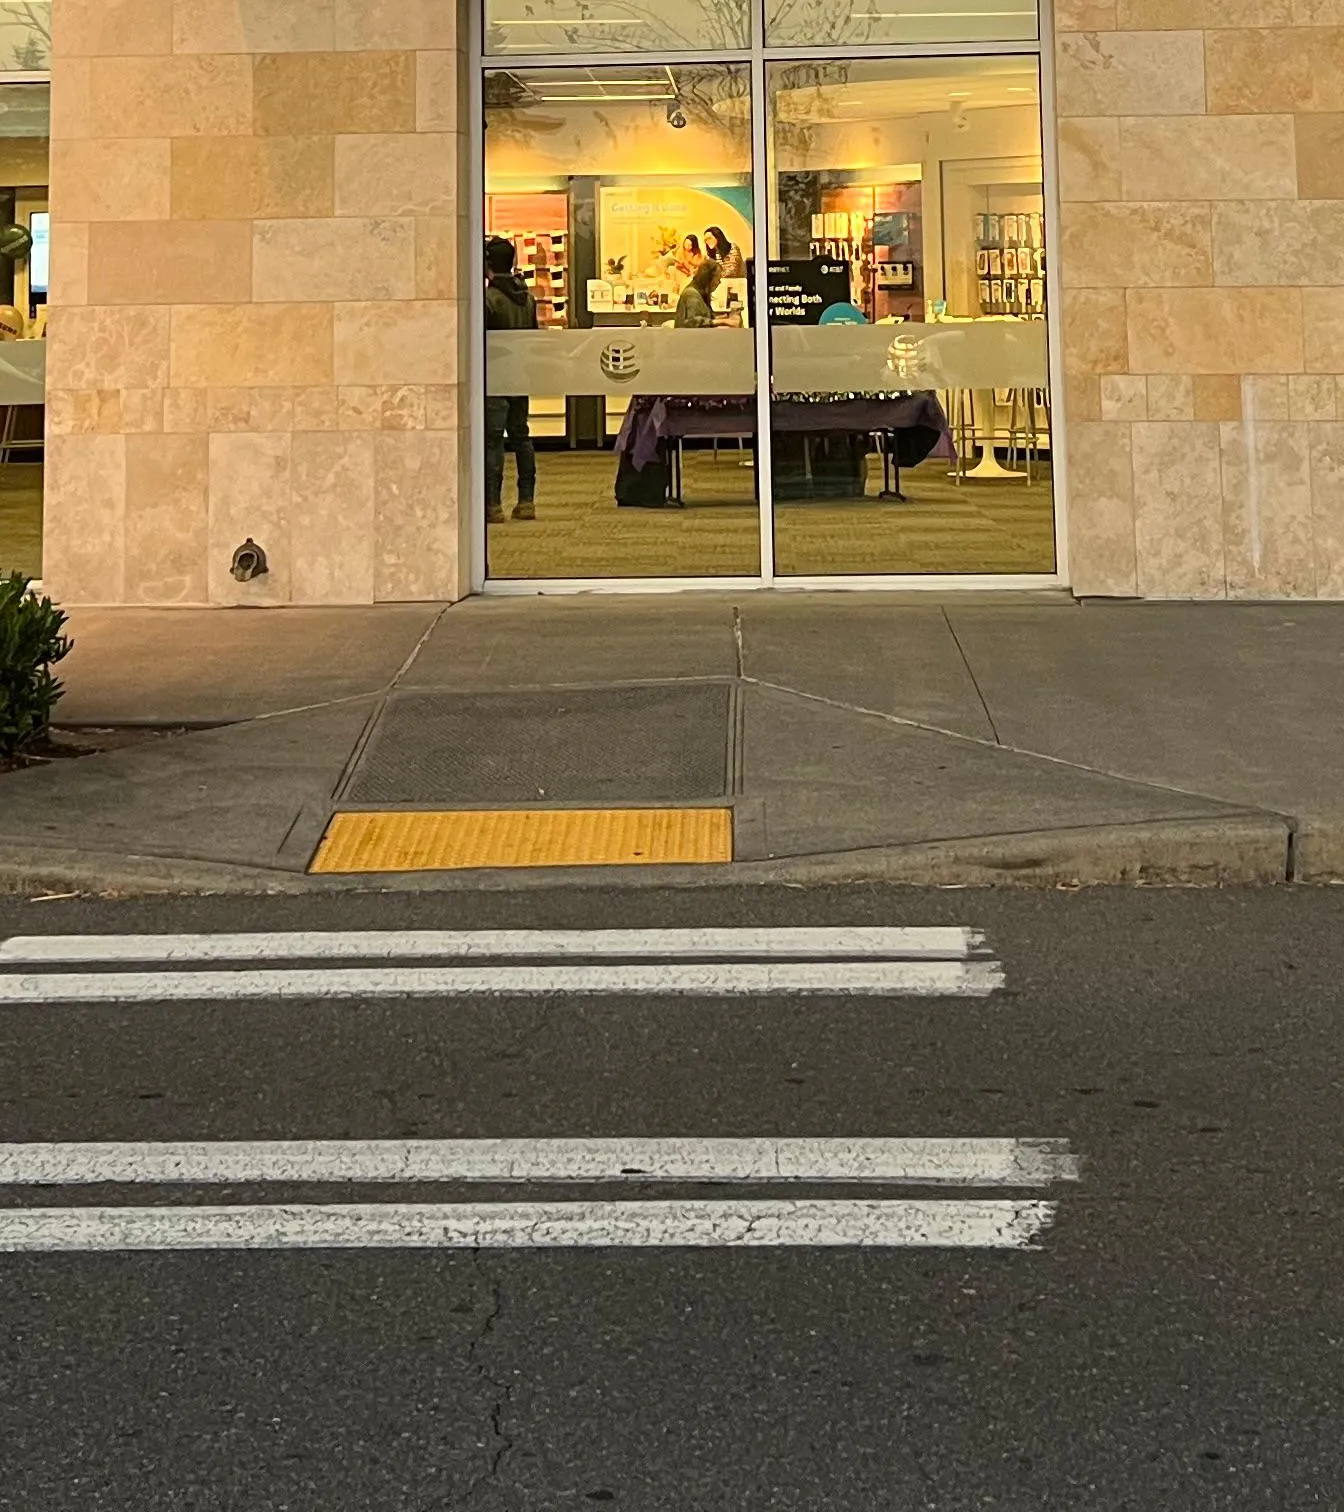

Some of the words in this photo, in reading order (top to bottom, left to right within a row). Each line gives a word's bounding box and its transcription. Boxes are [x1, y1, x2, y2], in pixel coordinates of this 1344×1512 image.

[769, 294, 800, 306] necting
[801, 293, 823, 304] Both
[775, 306, 806, 316] Worlds
